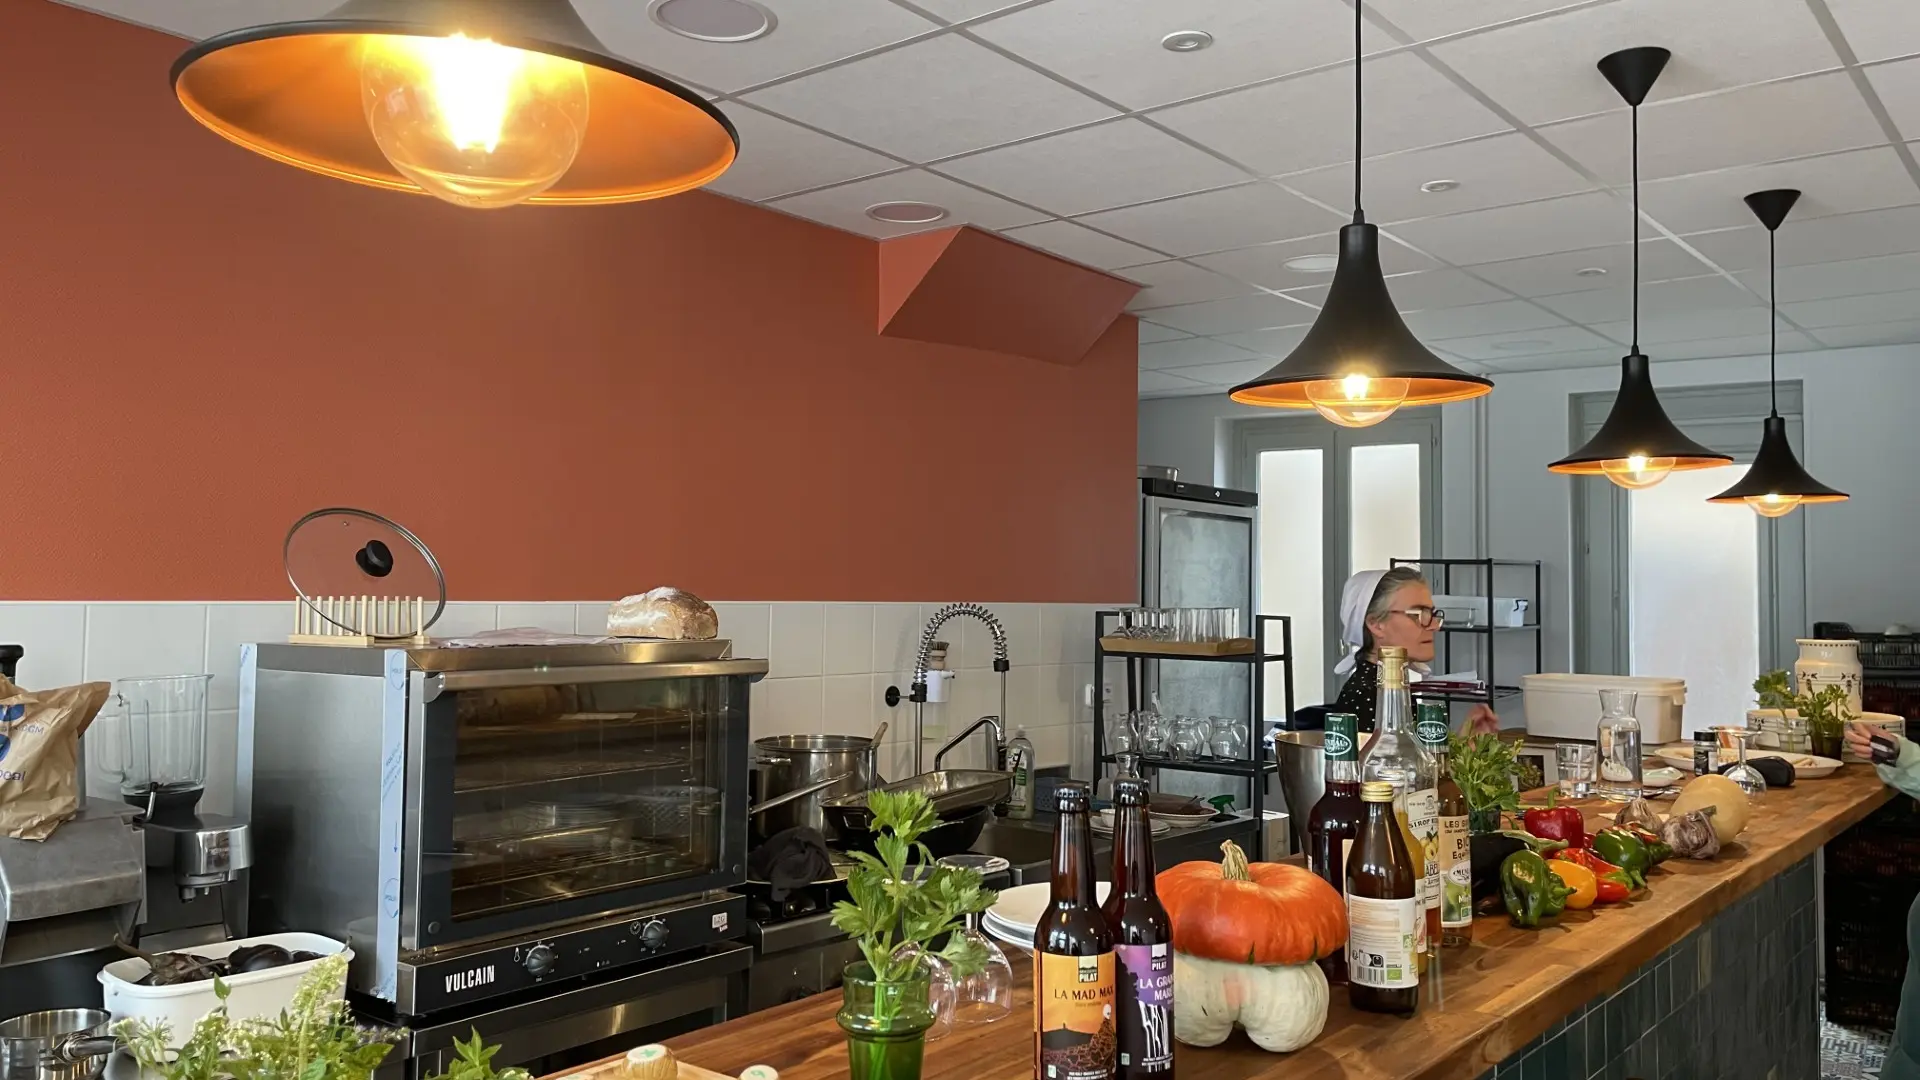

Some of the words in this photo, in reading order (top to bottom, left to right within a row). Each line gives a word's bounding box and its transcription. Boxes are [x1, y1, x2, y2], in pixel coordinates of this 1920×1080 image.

[1444, 820, 1460, 829] LES
[1151, 961, 1167, 971] PILAT
[445, 964, 495, 993] VULCAIN
[1079, 972, 1097, 983] PILAT
[1140, 978, 1154, 989] LA
[1054, 988, 1068, 1000] LA
[1072, 989, 1096, 1001] MAD
